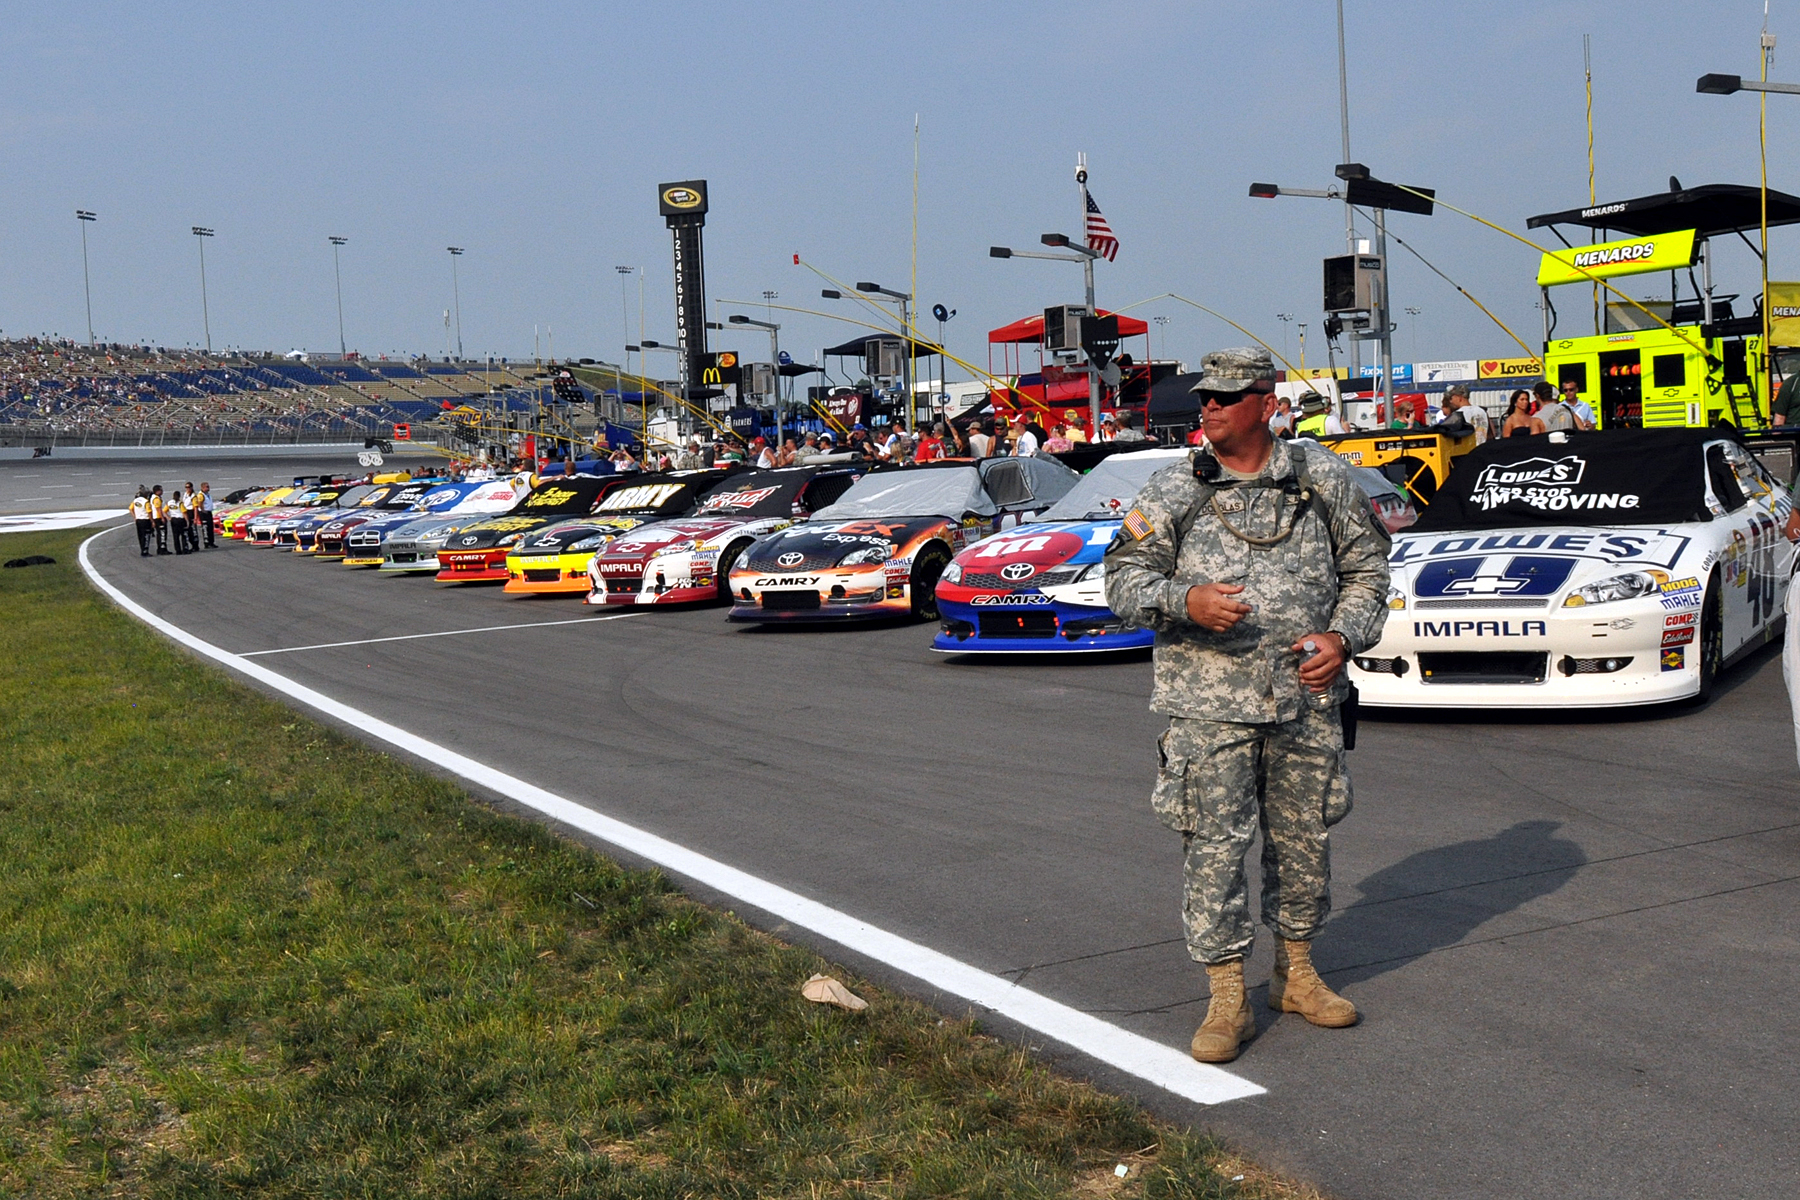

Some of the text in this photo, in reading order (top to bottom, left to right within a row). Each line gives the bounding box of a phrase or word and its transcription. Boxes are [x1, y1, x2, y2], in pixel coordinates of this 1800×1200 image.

[1581, 204, 1626, 218] MENARDS
[675, 240, 681, 249] 2
[675, 251, 681, 260] 3
[1574, 242, 1655, 267] MENARDS
[676, 262, 682, 271] 4
[676, 273, 682, 282] 5
[677, 284, 683, 293] 6
[677, 295, 683, 304] 7
[678, 306, 684, 315] 8
[679, 317, 684, 326] 9
[678, 328, 687, 338] 10
[680, 340, 686, 348] 11
[1748, 340, 1759, 350] 27
[732, 417, 752, 427] FARMERS
[1485, 464, 1574, 483] LOWE'S
[1526, 487, 1572, 499] STOP
[591, 483, 686, 515] ARMY
[822, 533, 891, 546] Express
[389, 542, 417, 550] IMPALA
[1388, 533, 1648, 562] LOWE'S
[520, 555, 559, 564] IMPALA
[691, 552, 717, 560] MAHLE
[885, 557, 912, 567] MAHLE
[600, 564, 643, 573] IMPALA
[754, 576, 821, 587] CAMRY
[1661, 578, 1698, 592] MOOG
[970, 594, 1056, 605] CAMRY
[1660, 593, 1700, 609] MAHLE
[1665, 613, 1693, 626] COMP
[1414, 620, 1546, 637] IMPALA
